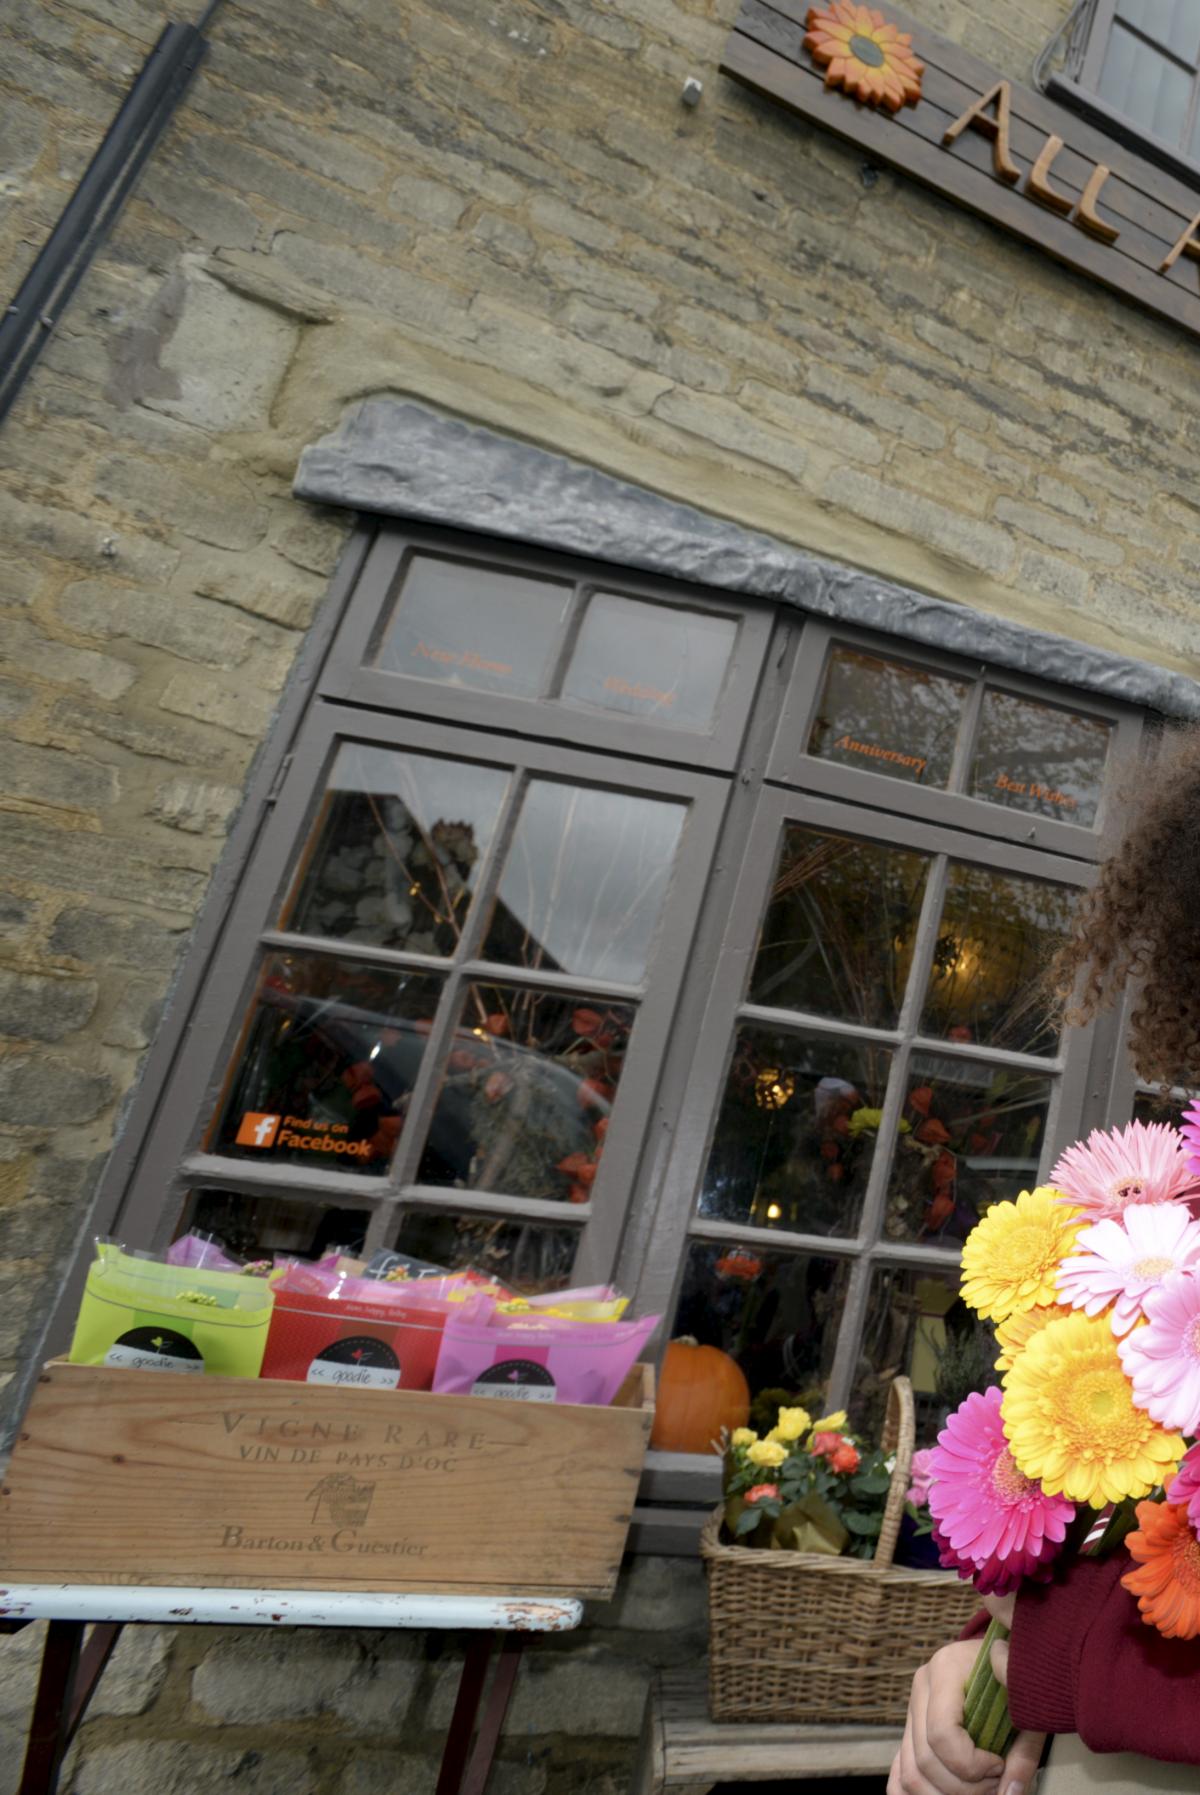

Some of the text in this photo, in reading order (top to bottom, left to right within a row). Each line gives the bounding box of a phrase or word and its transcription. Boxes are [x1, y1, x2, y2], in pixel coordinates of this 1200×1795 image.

[833, 735, 927, 777] Anniversary
[995, 773, 1026, 794] Best
[284, 1115, 349, 1133] Find us on
[277, 1129, 373, 1156] Facebook
[332, 1368, 372, 1385] goodie
[221, 1411, 487, 1450] VIGNE RARE
[239, 1445, 280, 1462] VIN
[291, 1448, 321, 1465] DE
[336, 1451, 388, 1468] PAYS
[219, 1524, 428, 1557] Barton & Guestier
